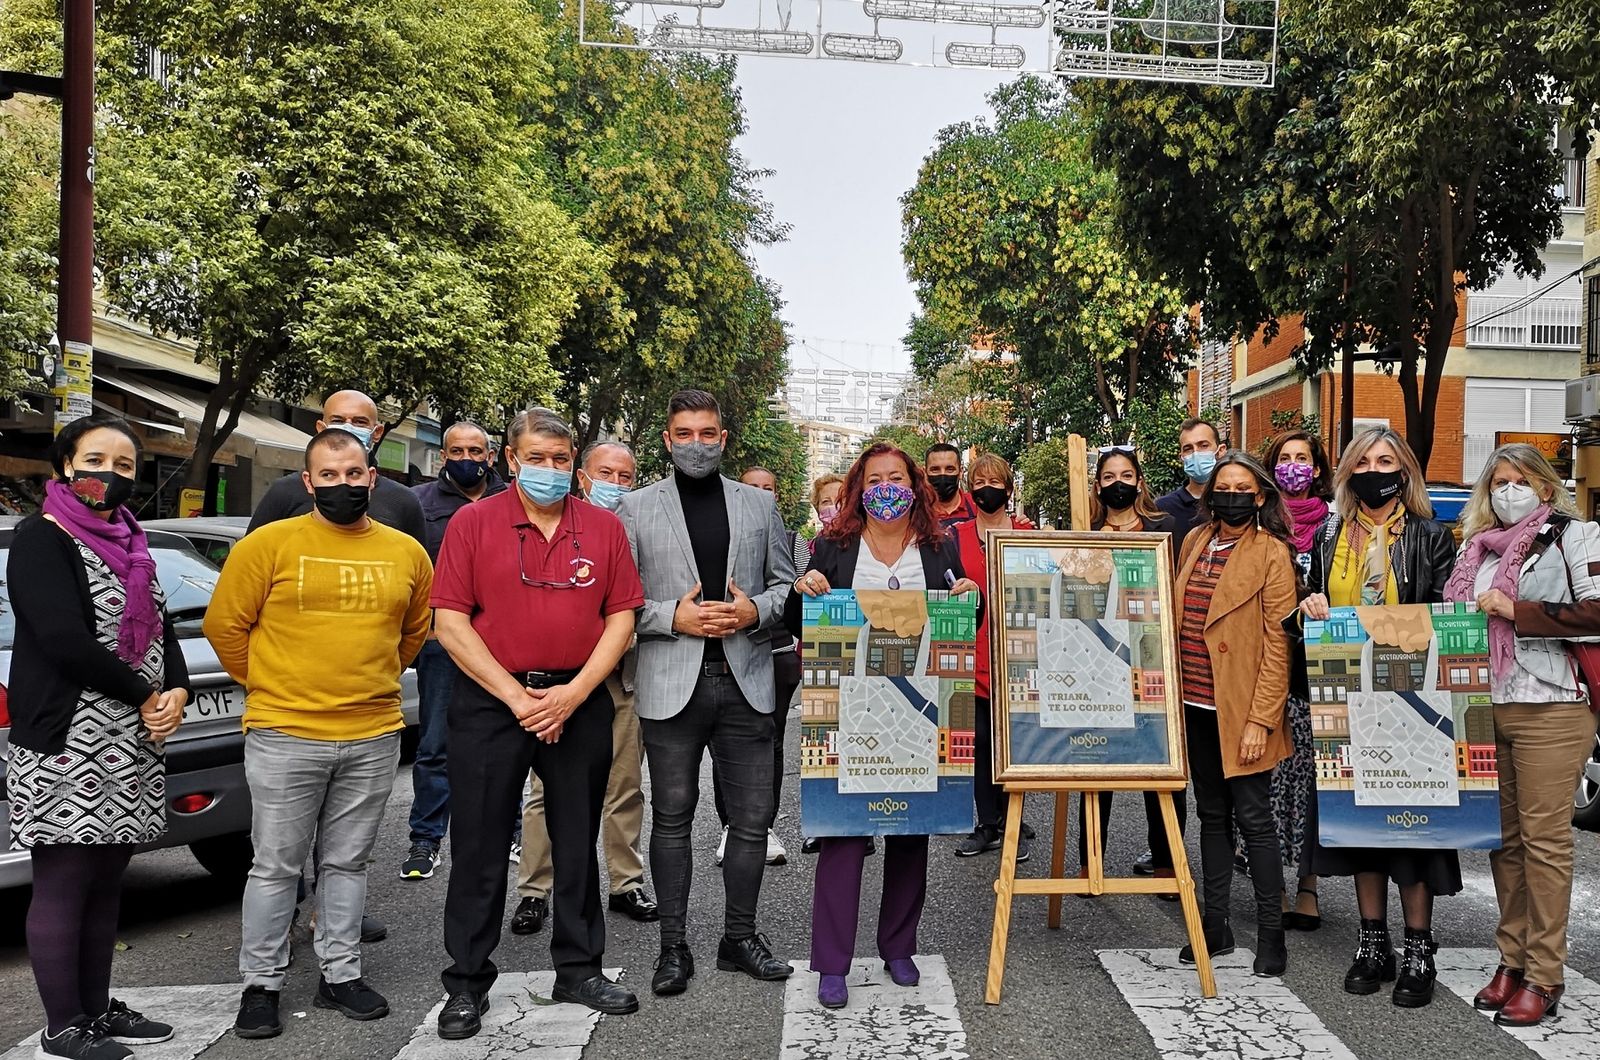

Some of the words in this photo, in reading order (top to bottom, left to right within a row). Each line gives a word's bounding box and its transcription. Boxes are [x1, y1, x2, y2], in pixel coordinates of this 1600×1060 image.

[196, 689, 233, 716] CYF
[1048, 704, 1061, 712] TE
[1063, 704, 1077, 712] LO
[1079, 703, 1126, 712] COMPRO!
[847, 768, 861, 776] TE
[863, 768, 877, 776] LO
[879, 767, 929, 776] COMPRO!
[1363, 780, 1377, 789] TE
[1379, 780, 1394, 789] LO
[1396, 780, 1449, 789] COMPRO!
